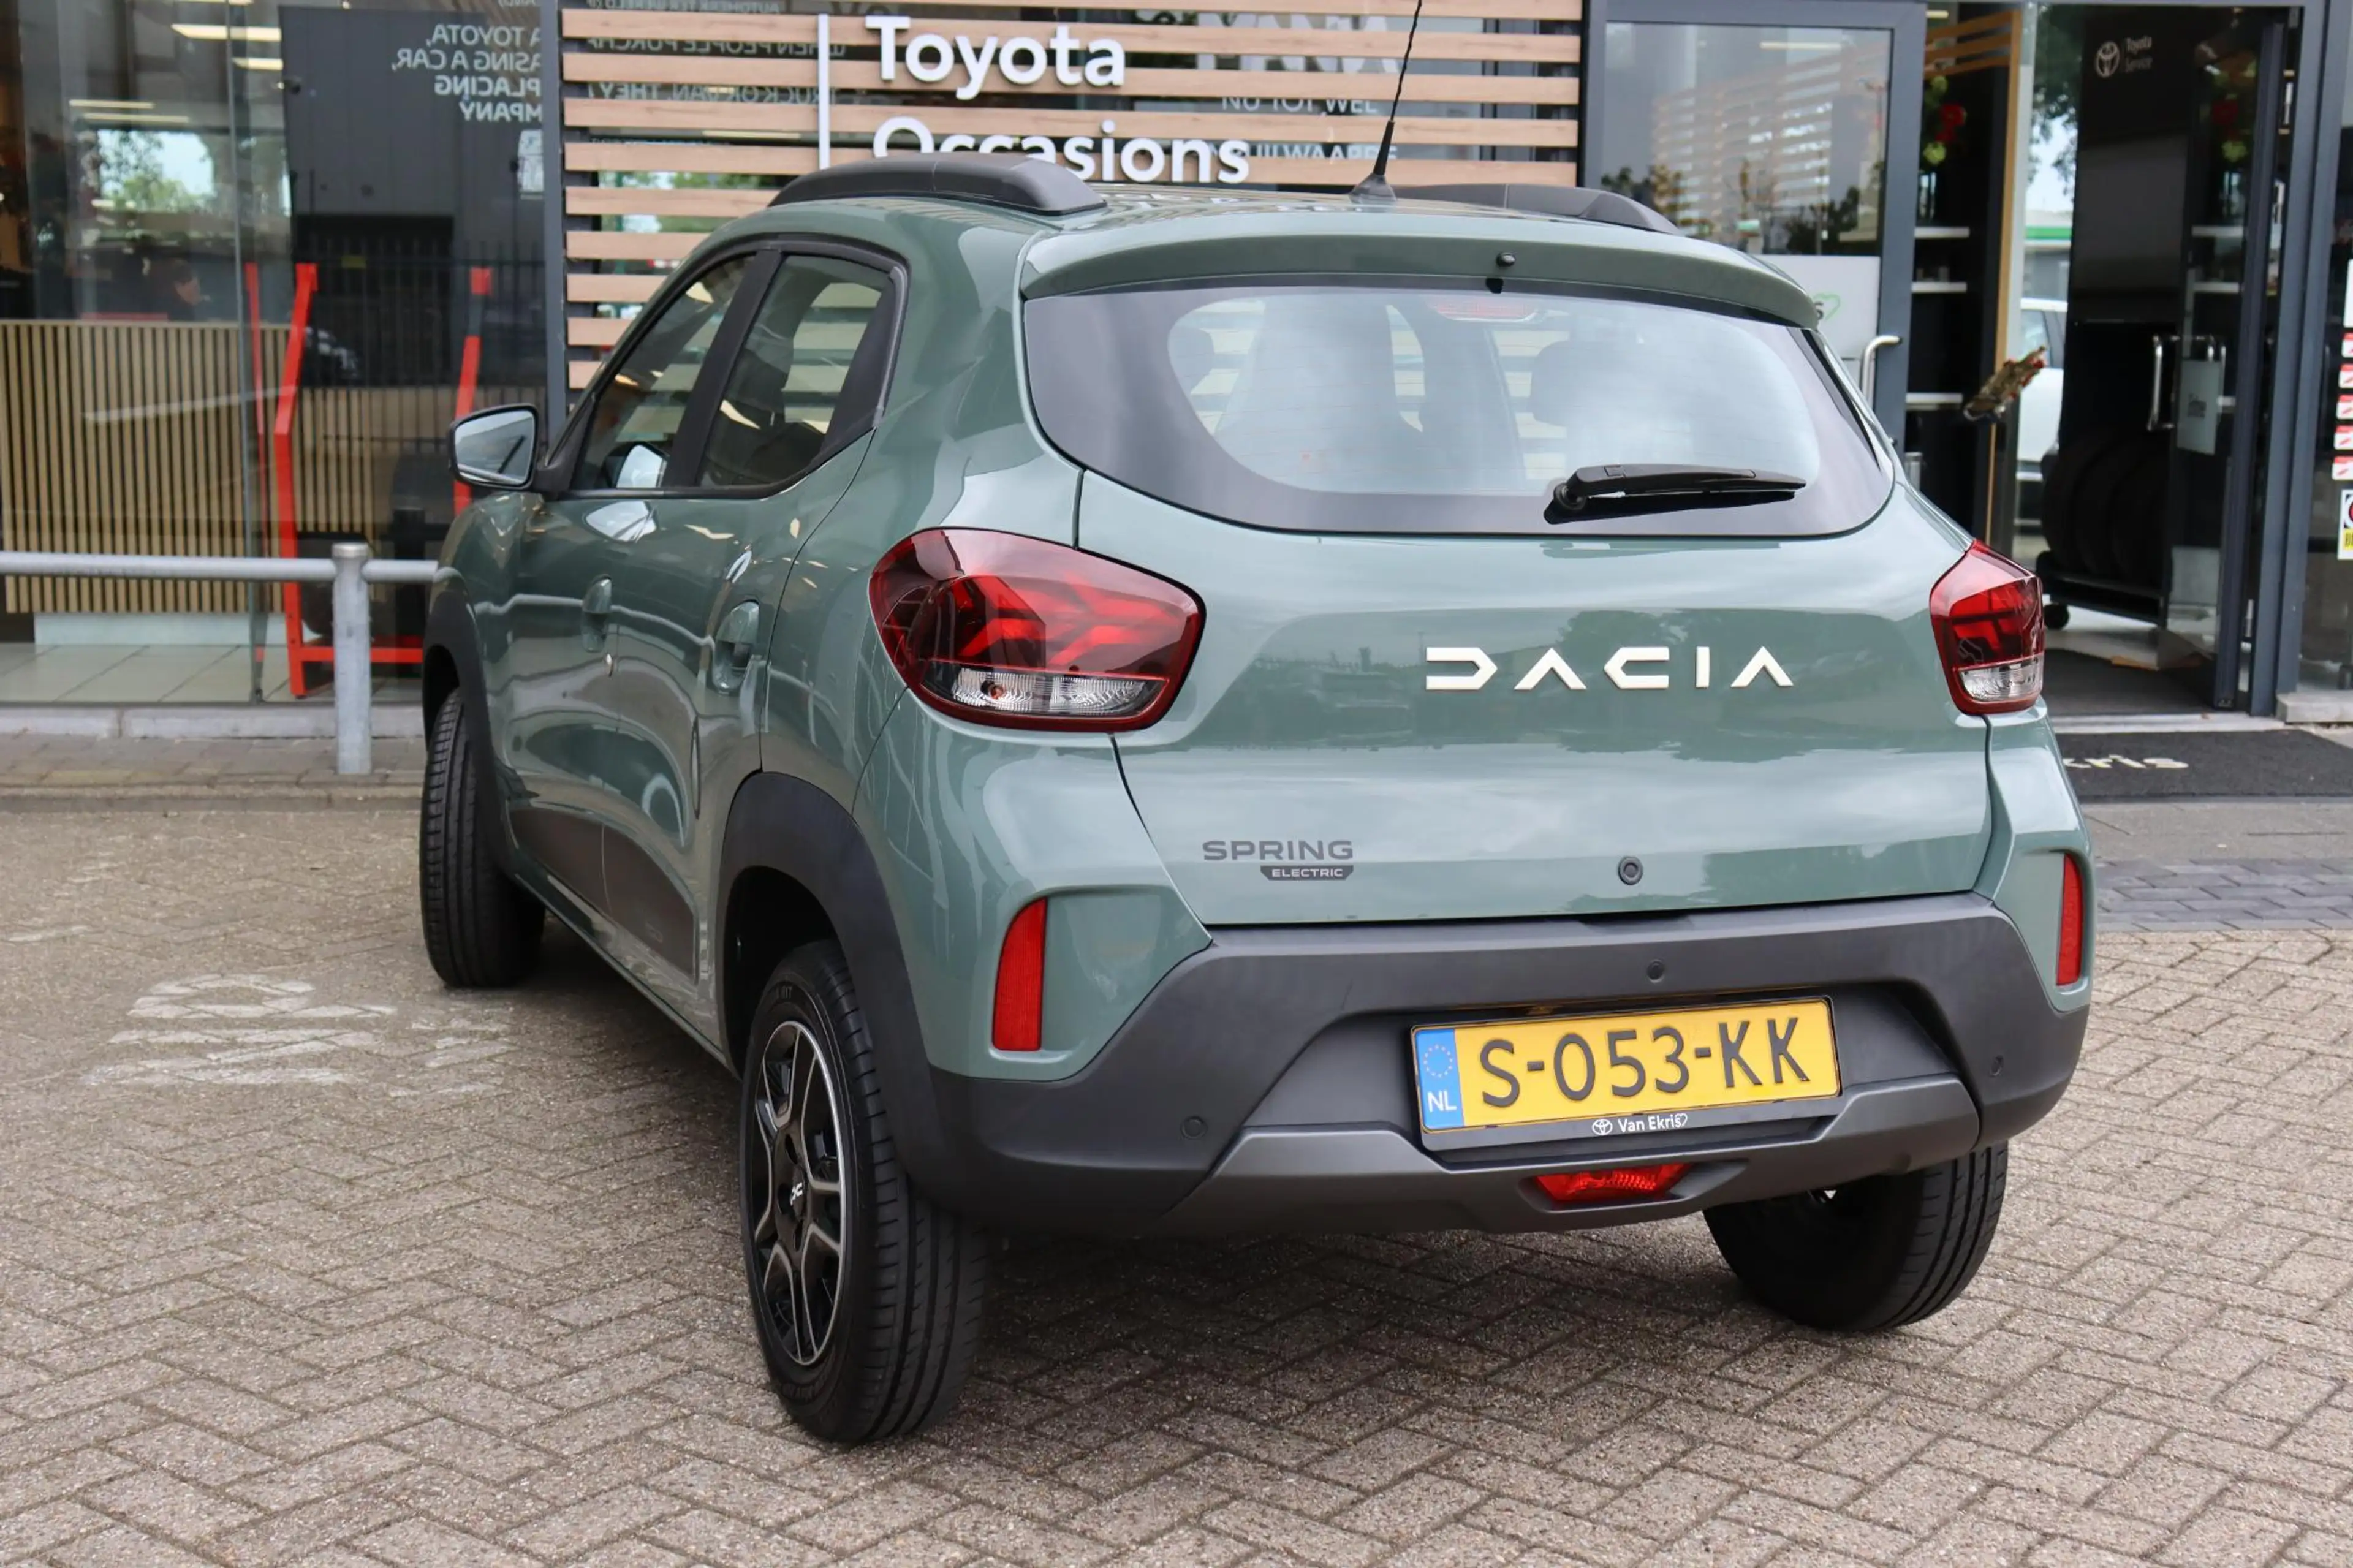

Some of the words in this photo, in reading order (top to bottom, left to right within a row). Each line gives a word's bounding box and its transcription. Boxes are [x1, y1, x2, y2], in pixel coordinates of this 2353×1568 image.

[865, 15, 1125, 100] Toyota
[1425, 646, 1794, 691] DACIA
[1202, 840, 1354, 861] SPRING
[1271, 868, 1343, 878] ELECTRIC
[1479, 1017, 1811, 1108] S-053-KK
[1428, 1091, 1457, 1112] NL
[1618, 1118, 1645, 1132] Van
[1648, 1114, 1681, 1131] Ekris
